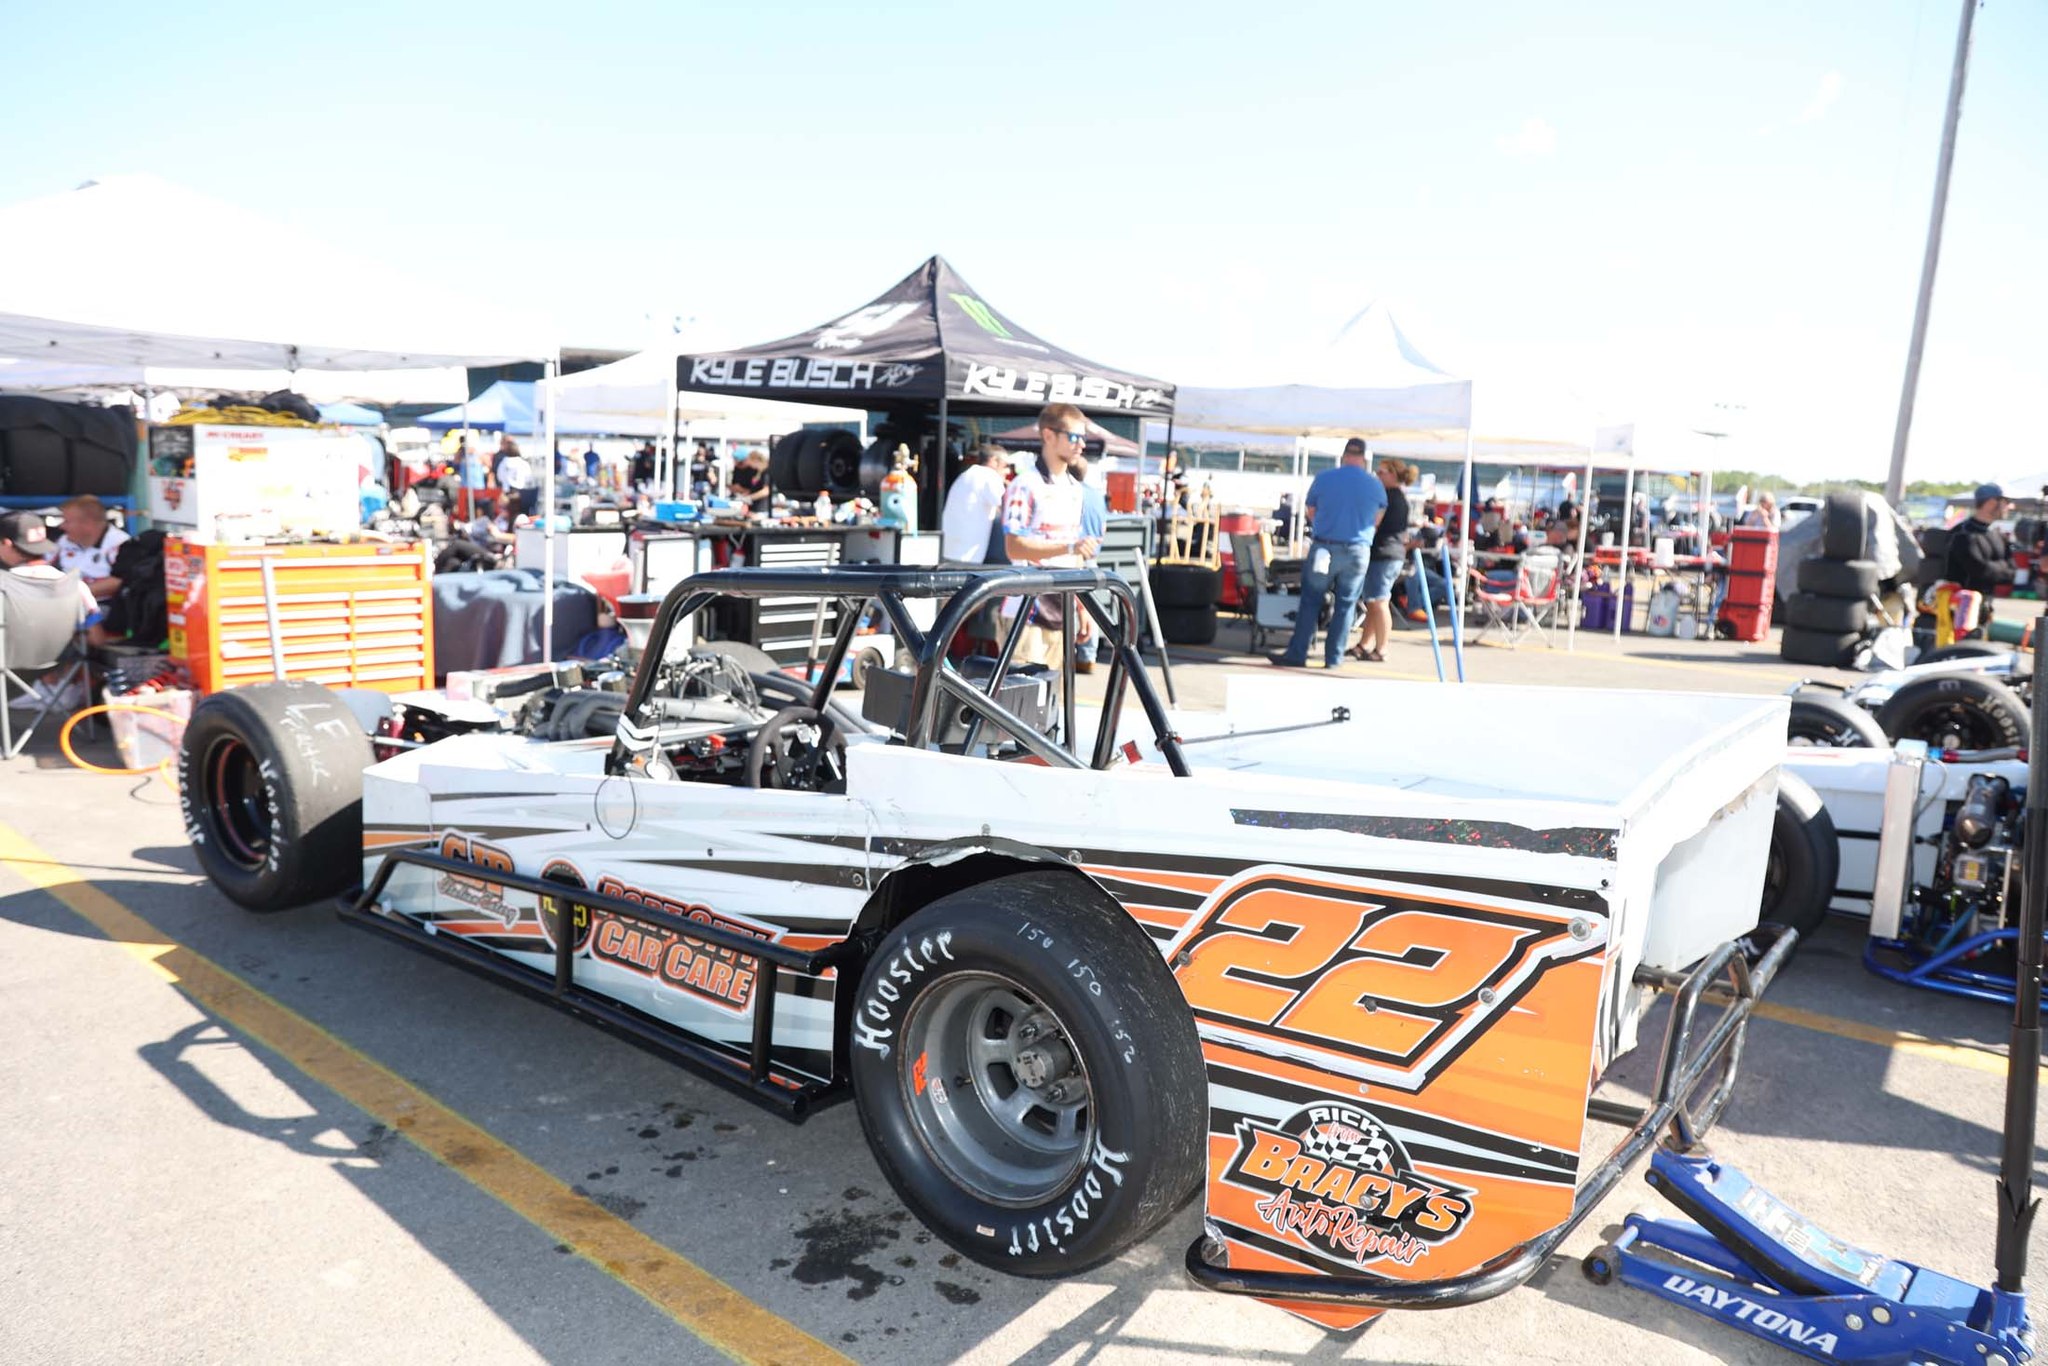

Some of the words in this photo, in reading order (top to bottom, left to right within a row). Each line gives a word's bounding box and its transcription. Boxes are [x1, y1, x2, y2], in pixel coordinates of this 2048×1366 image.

[690, 358, 768, 387] KYLE
[768, 359, 875, 390] BUSCH
[963, 362, 1047, 401] KYLE
[1049, 373, 1135, 409] BUSCH
[599, 919, 664, 970] CAR
[665, 943, 754, 1004] CARE
[855, 930, 954, 1062] Hoosier
[1177, 887, 1542, 1059] 22
[1308, 1107, 1383, 1138] RICK
[1008, 1129, 1129, 1256] Hoosier
[1239, 1129, 1466, 1232] BRACY'S
[1259, 1188, 1332, 1238] Auto
[1330, 1206, 1428, 1265] Repair
[1663, 1274, 1840, 1356] DAYTONA
